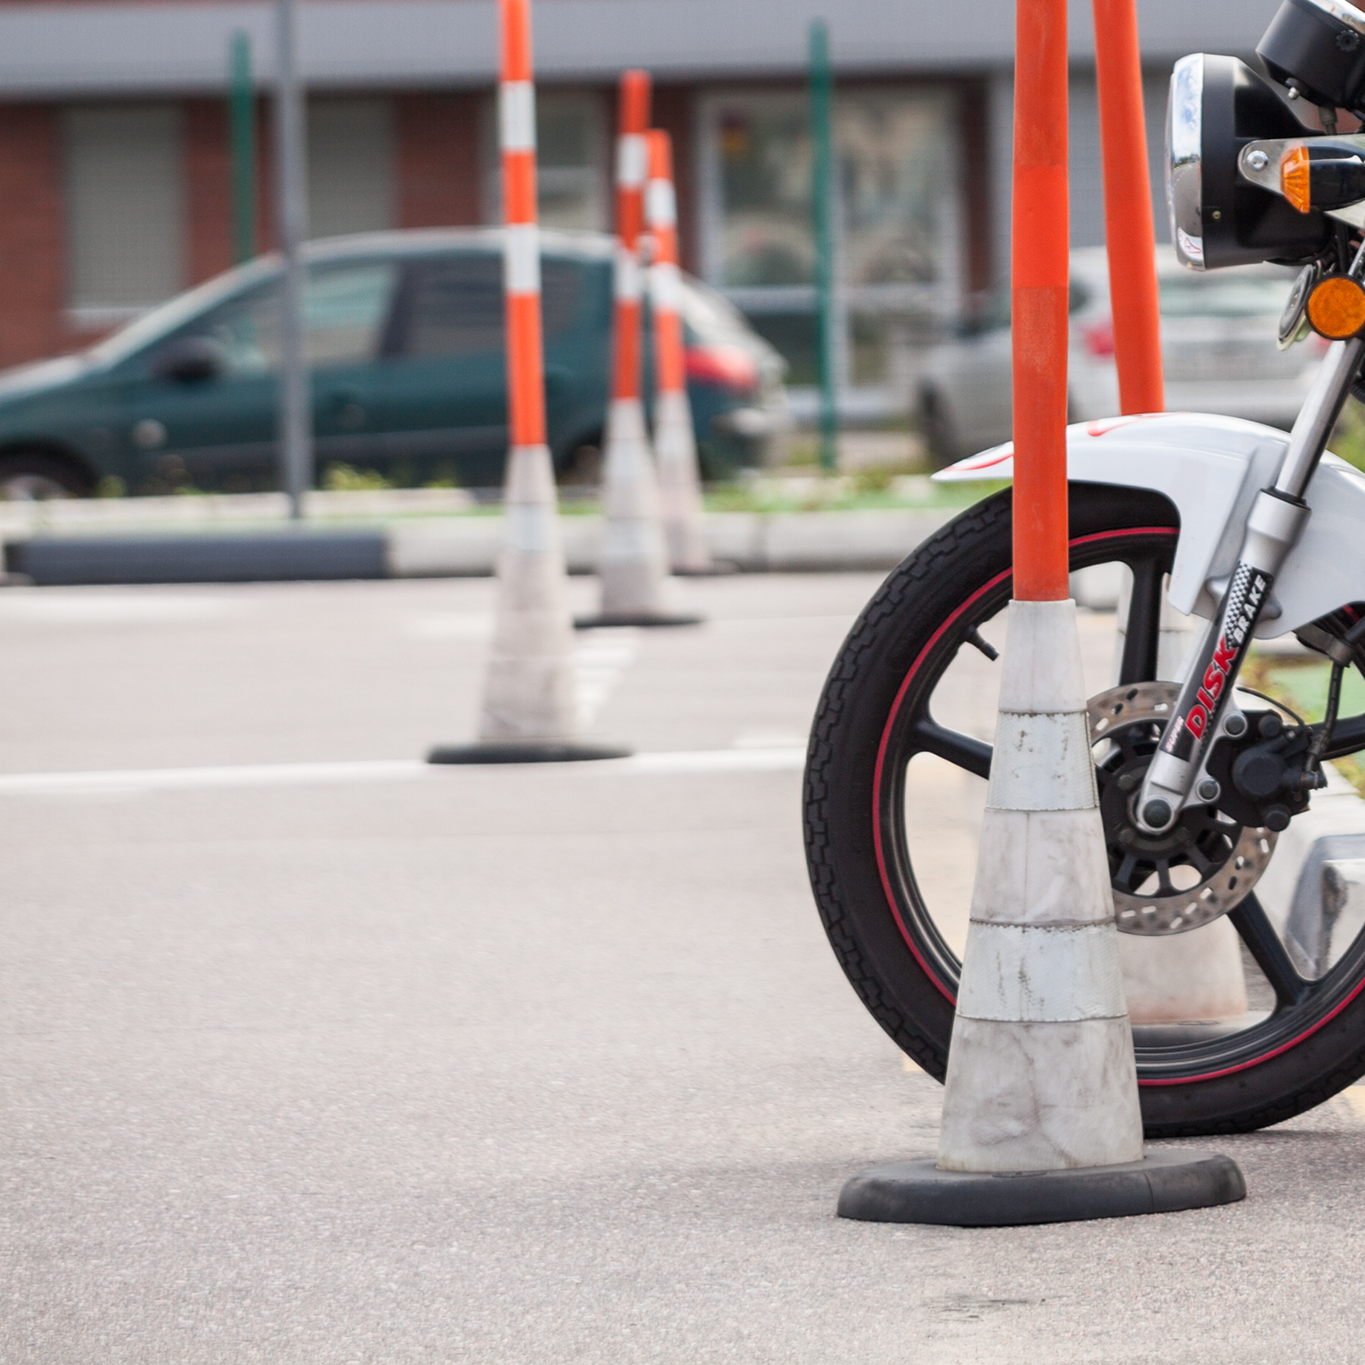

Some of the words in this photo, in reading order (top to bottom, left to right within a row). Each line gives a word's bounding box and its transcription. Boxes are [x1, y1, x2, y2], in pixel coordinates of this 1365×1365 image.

[1165, 715, 1185, 753] SUPER
[1185, 636, 1239, 741] DISK
[1232, 573, 1267, 645] BRAKE
